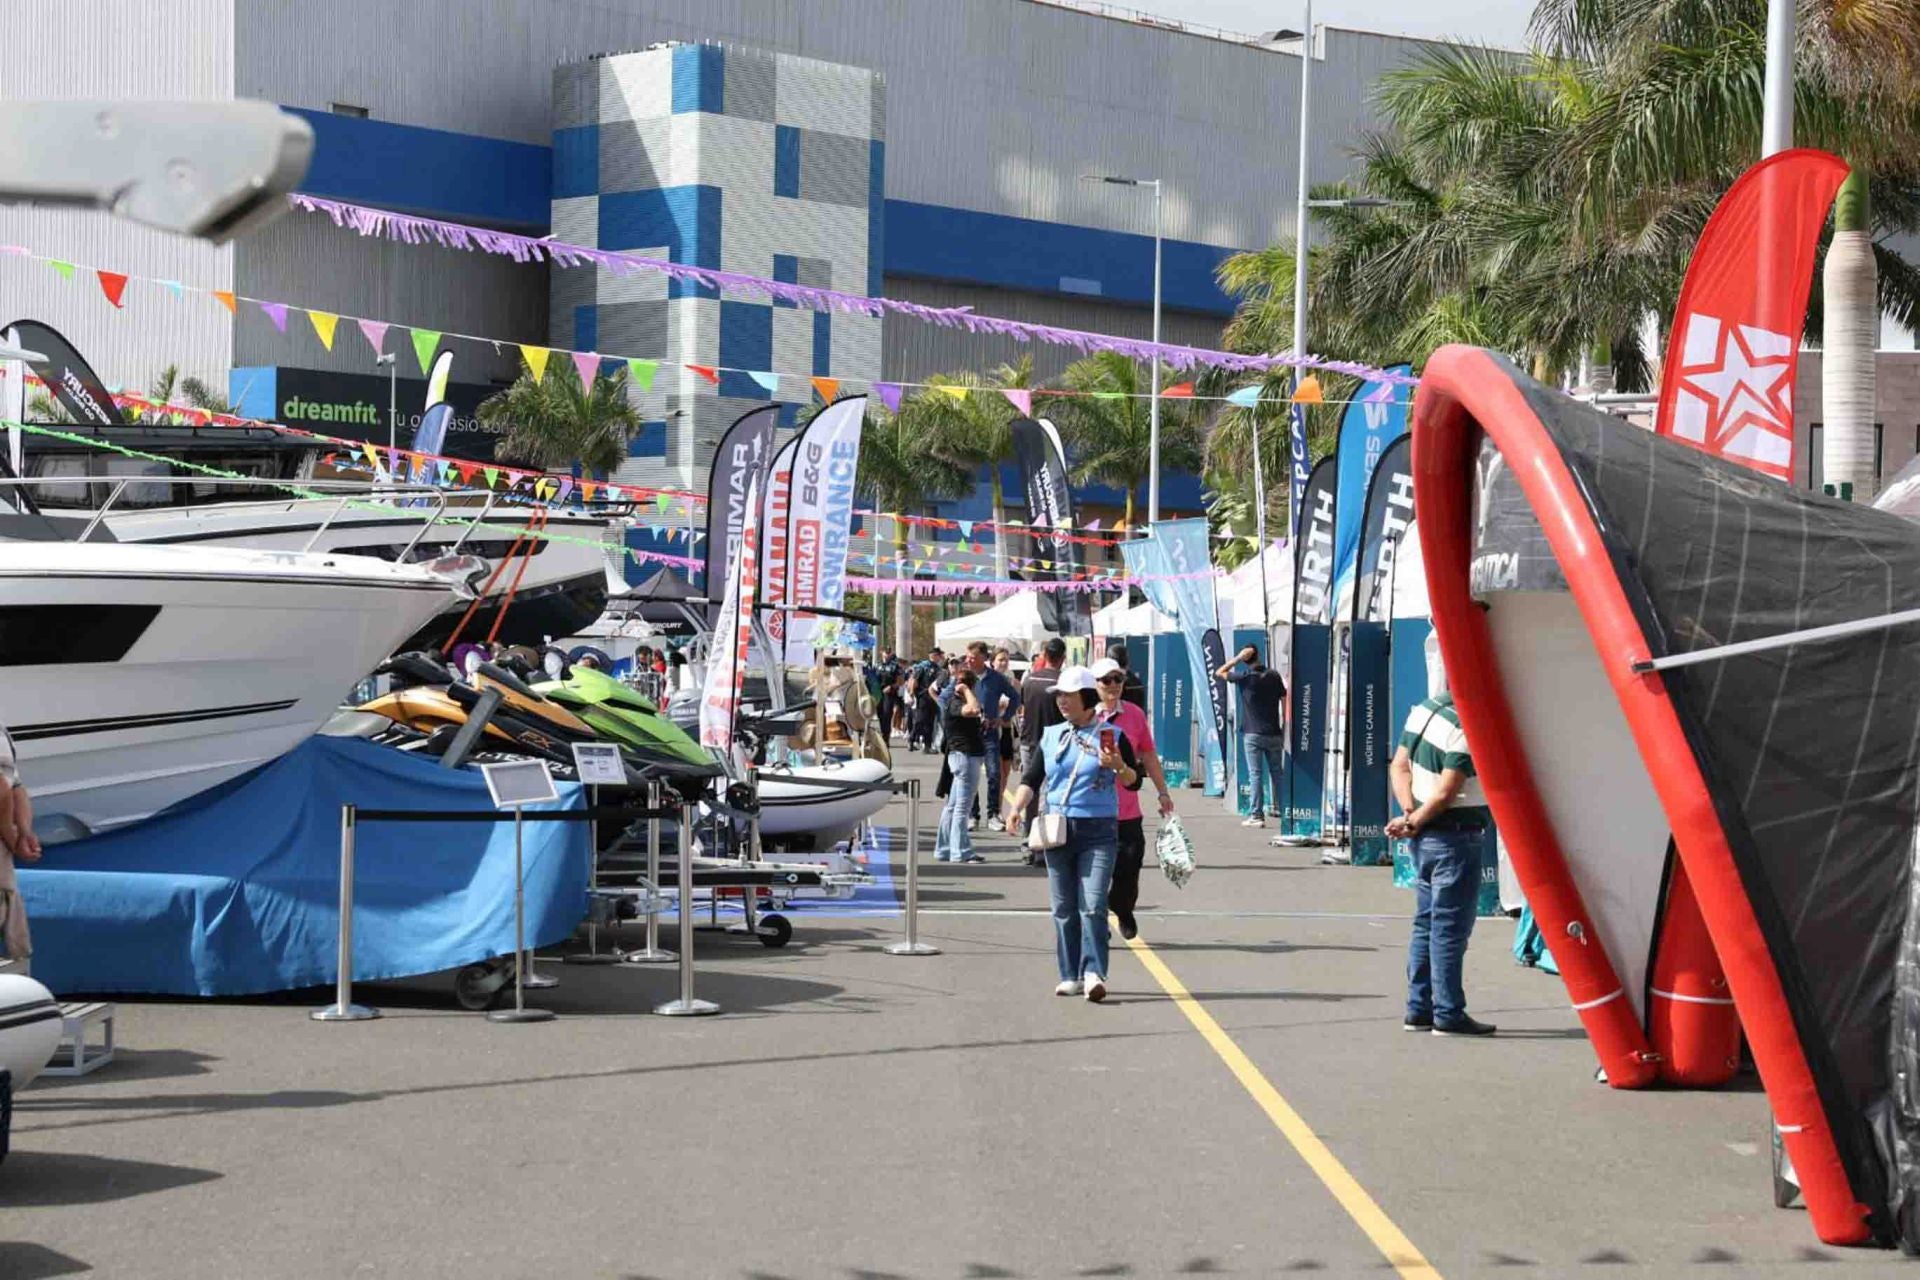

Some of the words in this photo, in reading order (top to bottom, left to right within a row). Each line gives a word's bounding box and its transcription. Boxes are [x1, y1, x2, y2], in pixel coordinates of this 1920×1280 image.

[802, 442, 823, 506] B&G
[1302, 684, 1311, 717] MARINA
[1366, 683, 1374, 731] CANARIAS
[1301, 718, 1309, 751] SEPCAN
